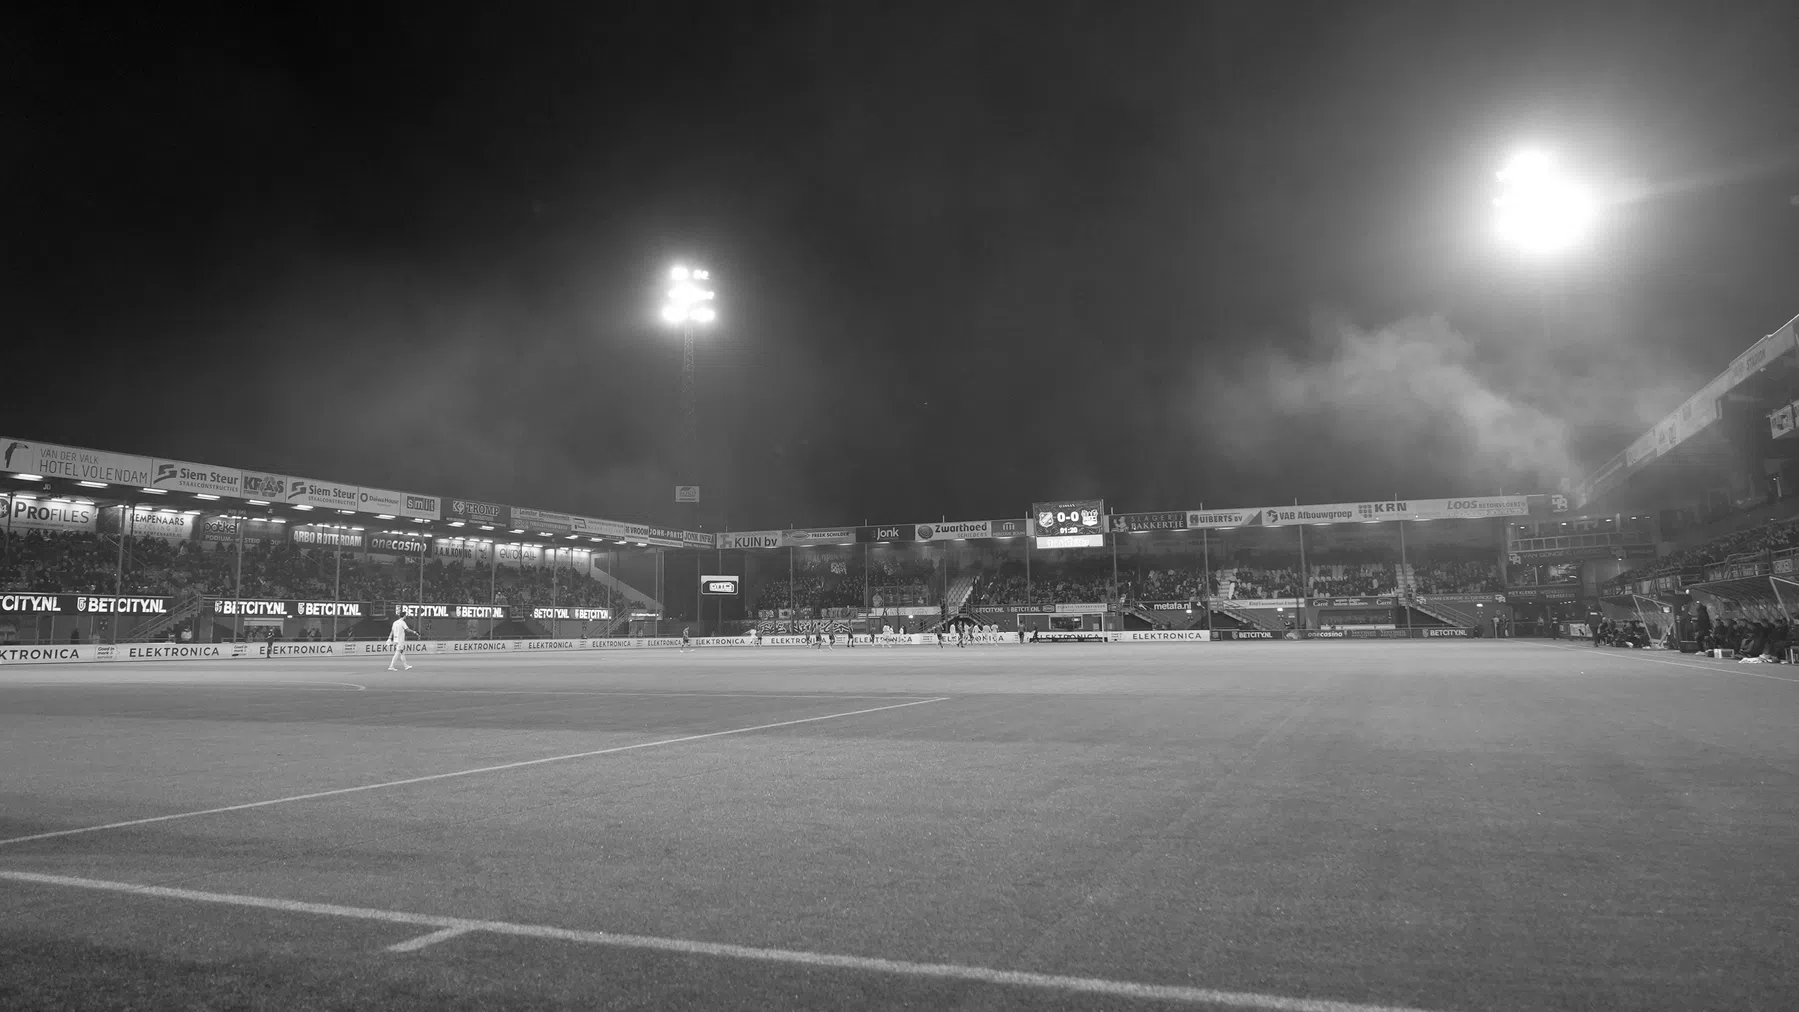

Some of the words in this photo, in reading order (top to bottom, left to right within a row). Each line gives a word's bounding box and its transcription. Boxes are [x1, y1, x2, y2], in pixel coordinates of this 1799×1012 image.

[41, 448, 58, 459] VAN
[60, 452, 76, 462] DER
[80, 454, 99, 465] VALK
[40, 460, 78, 476] HOTEL
[82, 465, 148, 484] VOLENDAM
[180, 468, 207, 481] Siem
[210, 472, 238, 485] Steur
[180, 480, 238, 492] STAALCONSTRUCTIES
[308, 485, 331, 496] Siem
[333, 488, 356, 500] Steur
[407, 496, 435, 512] smit
[466, 502, 500, 516] TROMP
[1374, 502, 1408, 513] KRN
[1447, 500, 1478, 510] LOOS
[14, 502, 90, 524] PROFILES
[1057, 511, 1079, 522] 0-0
[1131, 514, 1183, 522] SLAGERIJ
[1280, 512, 1295, 520] VAB
[1298, 510, 1352, 520] Afbouwgroep
[130, 514, 184, 526] KEMPENAARS
[935, 522, 988, 534] Zwarthoed
[294, 530, 315, 544] ARBO
[316, 532, 362, 547] ROTTERDAM
[734, 538, 762, 548] KUIN
[764, 536, 778, 547] bv
[372, 538, 426, 552] onecasino
[88, 597, 166, 613] BETCITY.NL
[224, 600, 288, 614] BETCITY.NL
[306, 602, 362, 616] BETCITY.NL
[402, 605, 448, 617] BETCITY.NL
[1154, 602, 1192, 610] metafa.nl
[129, 647, 220, 657] ELEKTRONICA
[260, 646, 333, 655] EEKTRONICA
